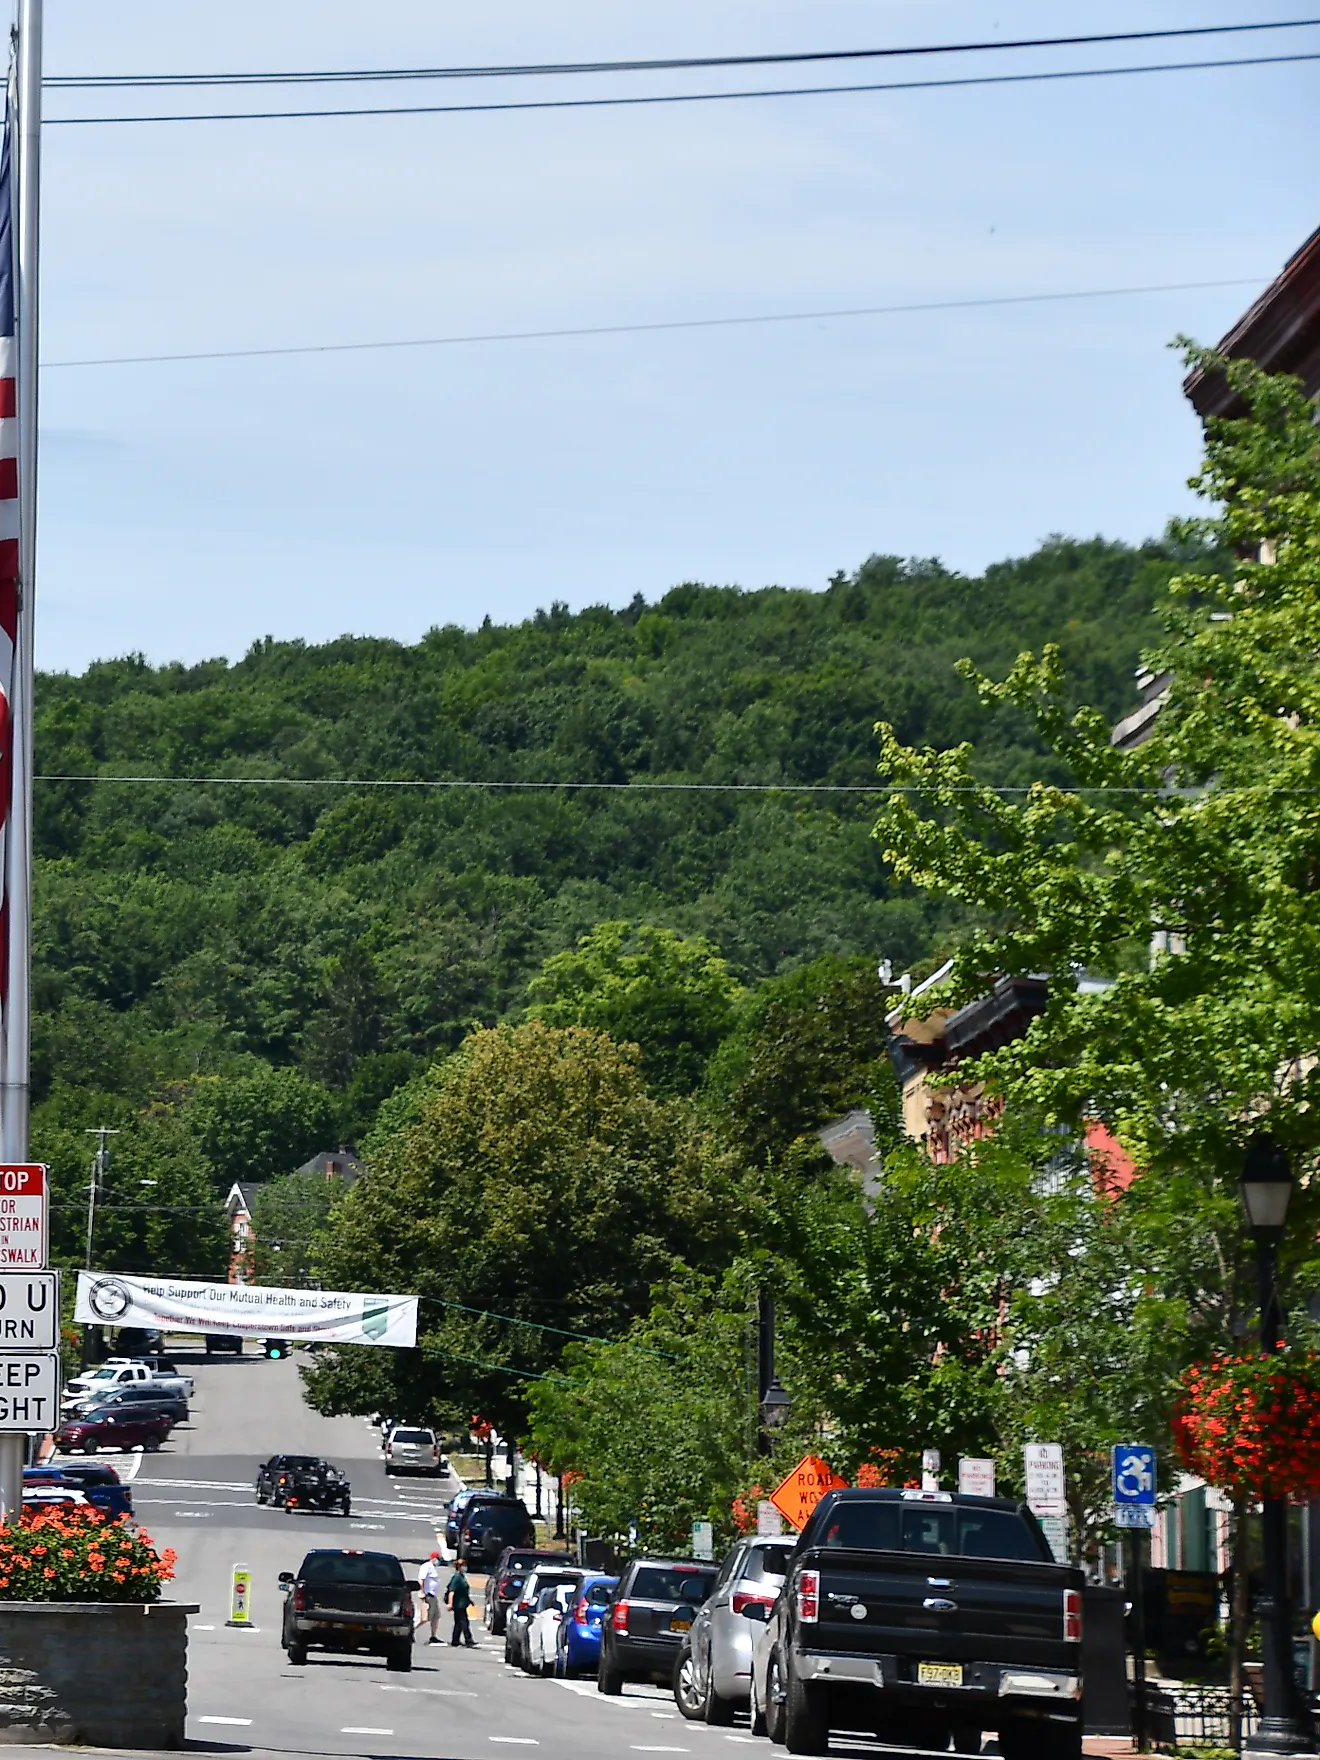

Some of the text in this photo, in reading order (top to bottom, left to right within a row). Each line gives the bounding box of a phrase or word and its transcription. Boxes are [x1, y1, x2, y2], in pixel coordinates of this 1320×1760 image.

[1, 1235, 9, 1245] IN
[28, 1283, 47, 1312] U
[143, 1283, 165, 1298] Help
[168, 1285, 206, 1300] Support
[209, 1289, 226, 1301] Our
[229, 1291, 263, 1304] Mutual
[266, 1293, 296, 1307] Health
[299, 1296, 318, 1308] and
[320, 1296, 352, 1311] Safety
[798, 1473, 834, 1486] ROAD
